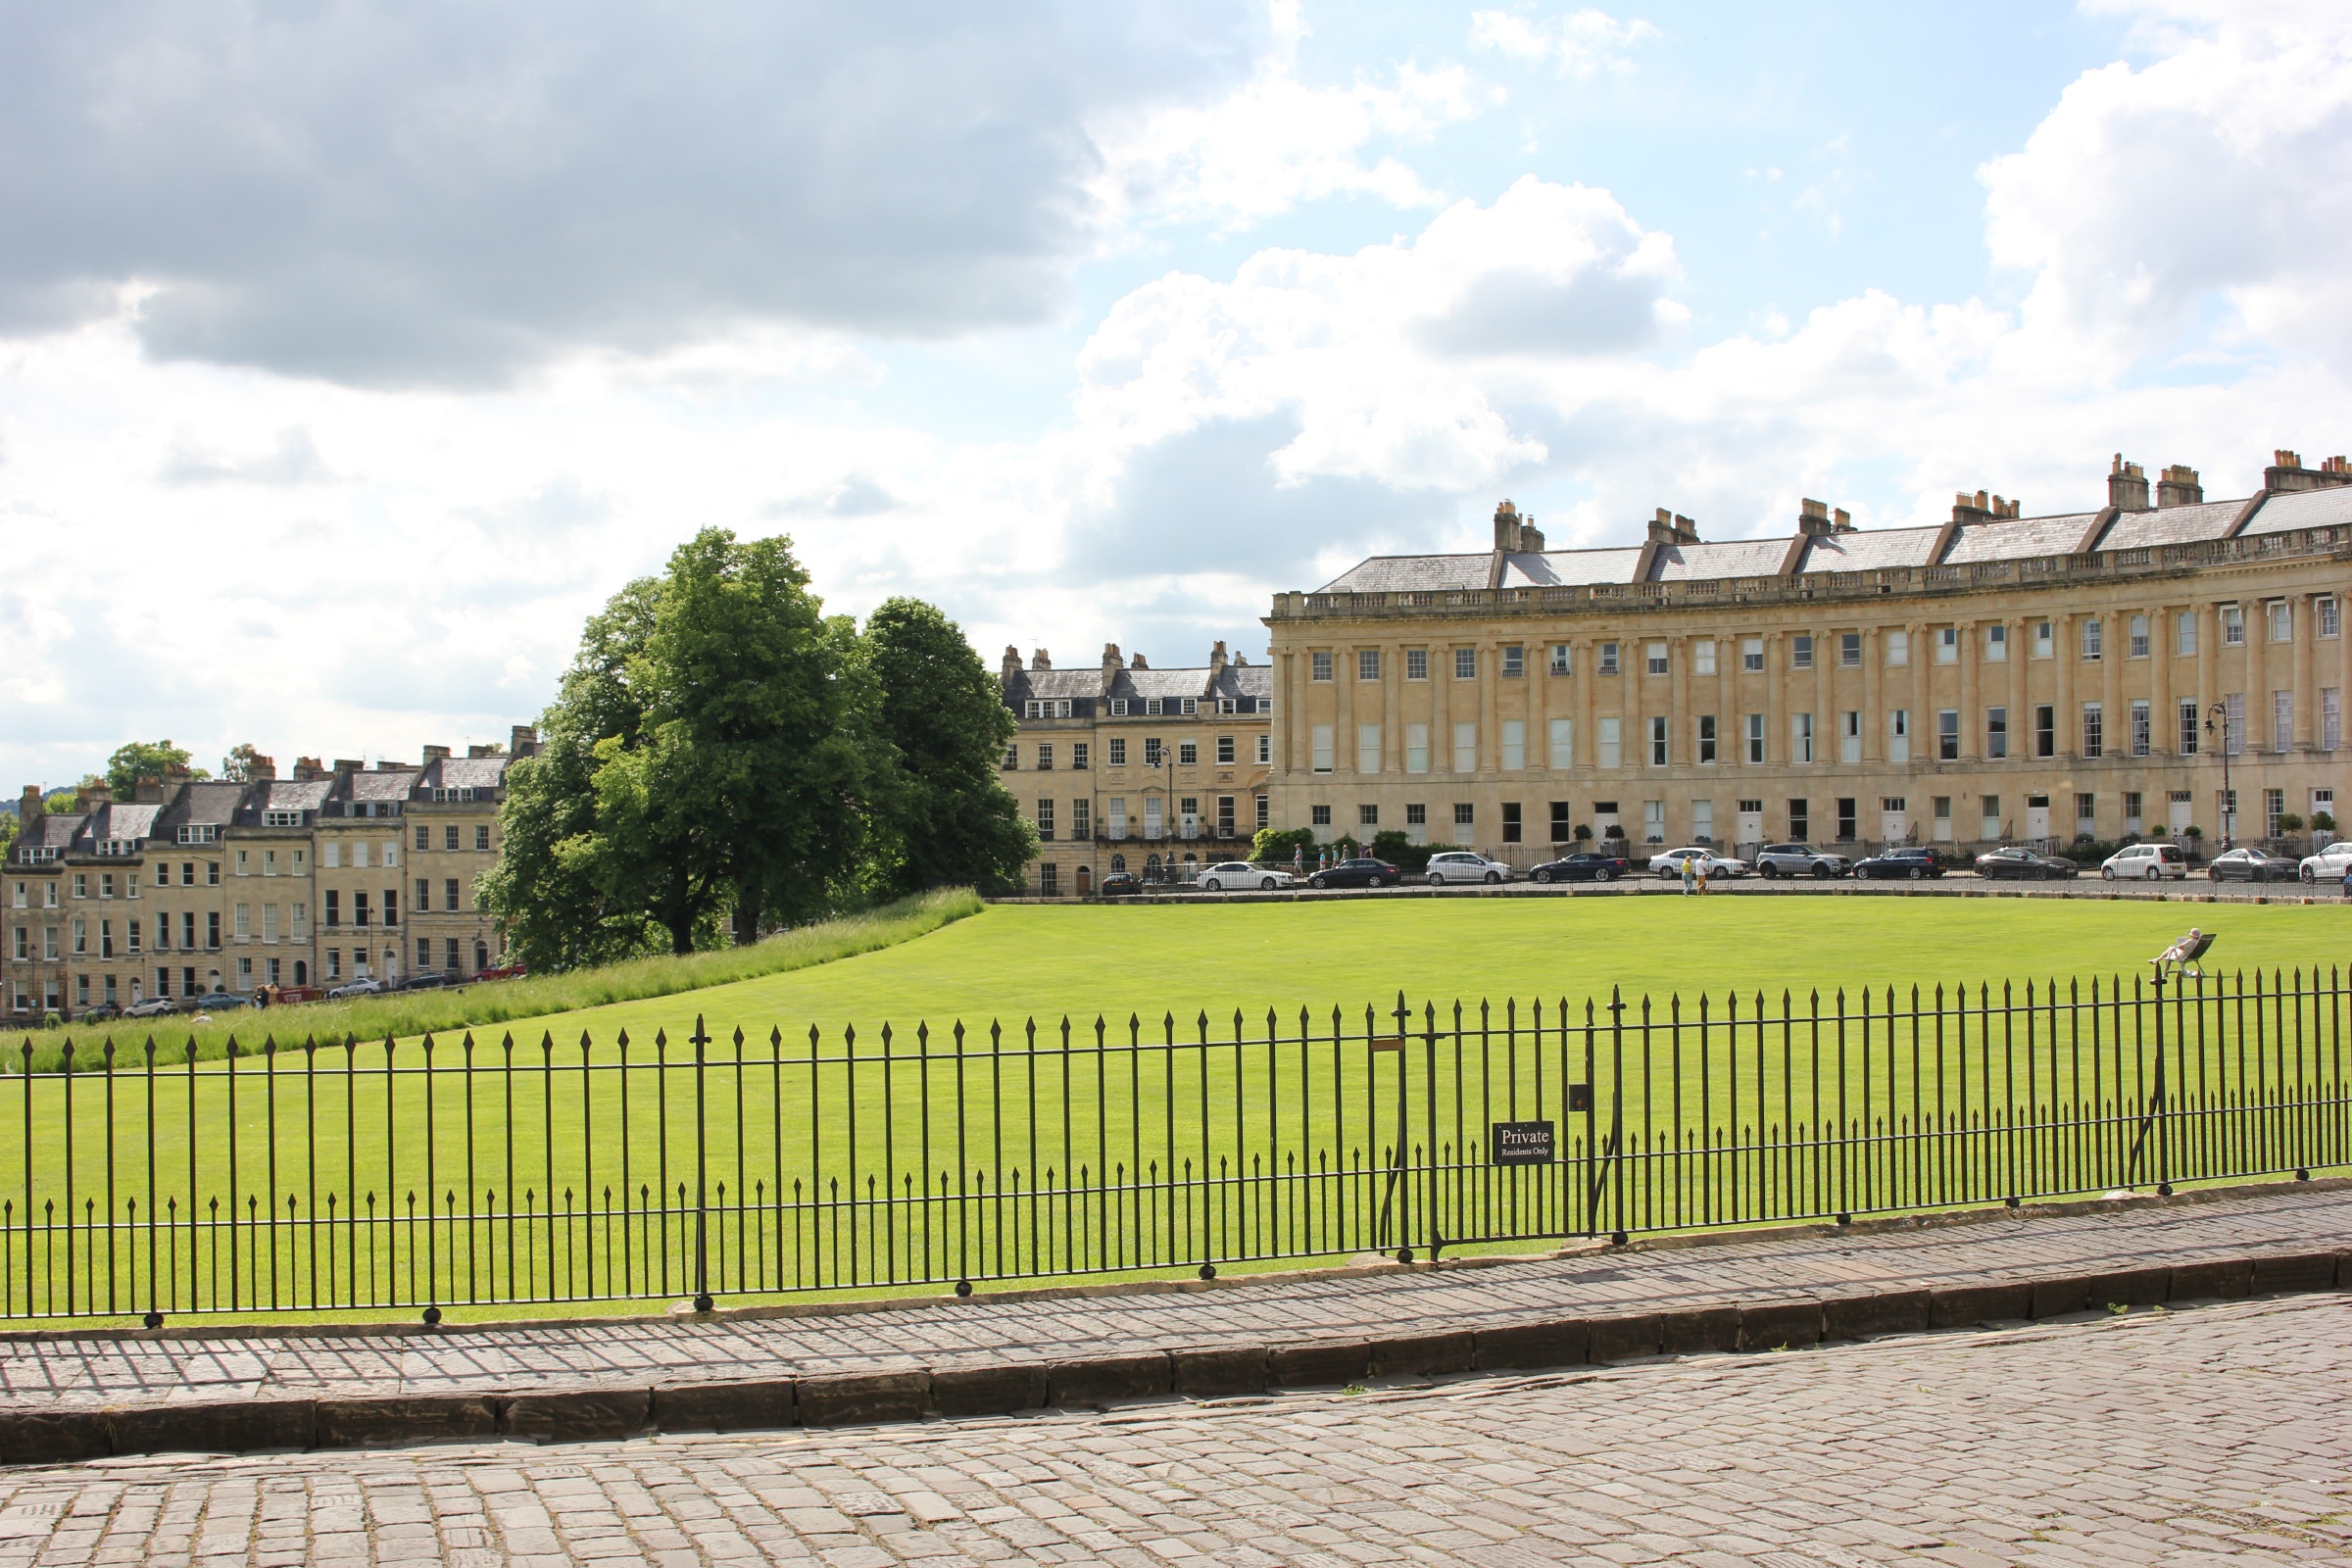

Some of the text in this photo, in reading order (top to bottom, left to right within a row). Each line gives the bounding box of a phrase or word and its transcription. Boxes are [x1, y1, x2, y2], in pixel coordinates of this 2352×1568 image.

[1501, 1128, 1549, 1145] Private
[1501, 1147, 1548, 1156] Residents Only
